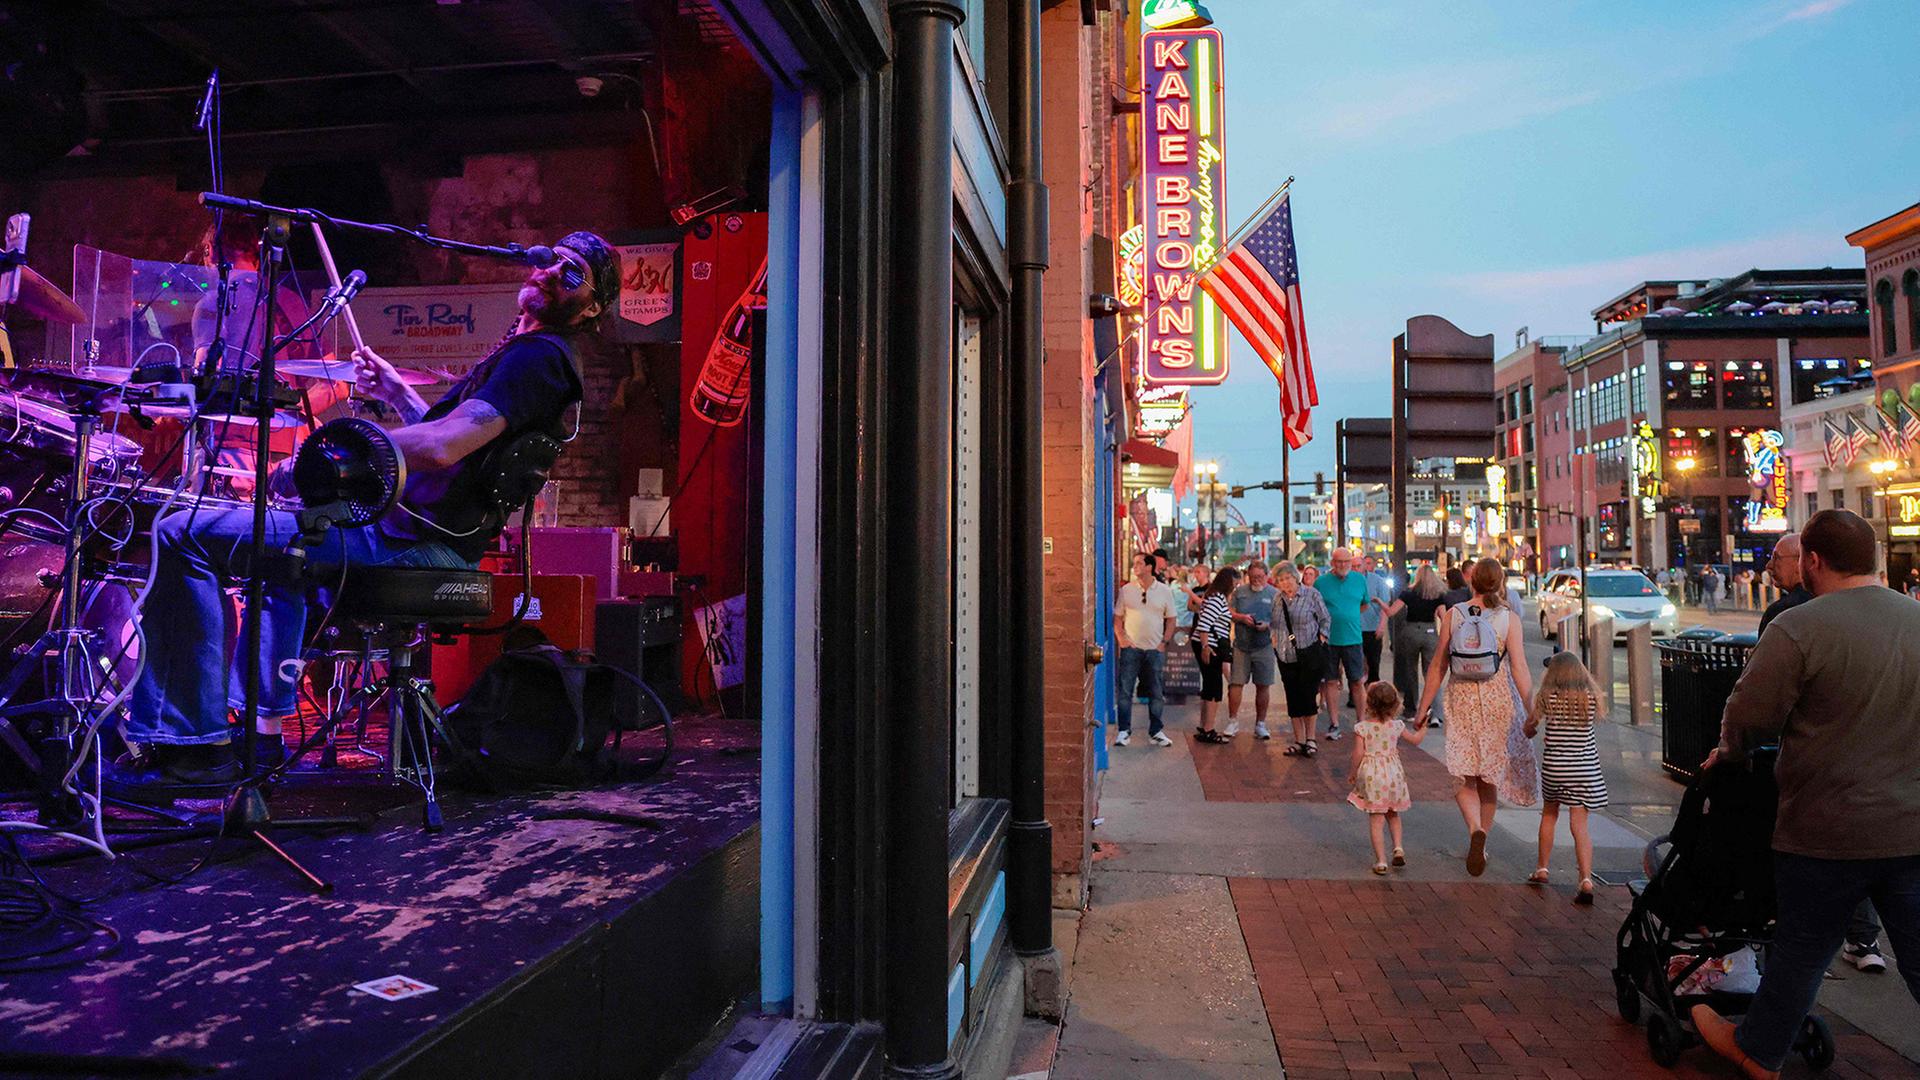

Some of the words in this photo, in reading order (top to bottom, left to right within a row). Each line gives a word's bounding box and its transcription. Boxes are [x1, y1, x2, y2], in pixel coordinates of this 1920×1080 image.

[1153, 40, 1191, 165] KANE
[1190, 138, 1221, 273] Broadway
[1151, 176, 1196, 369] BROWN'S
[383, 304, 424, 327] Tin
[425, 304, 476, 334] Roof
[624, 298, 669, 306] GREEN
[624, 307, 669, 315] STAMPS
[407, 326, 464, 337] BROADWAY
[1774, 457, 1791, 508] LUKE'S
